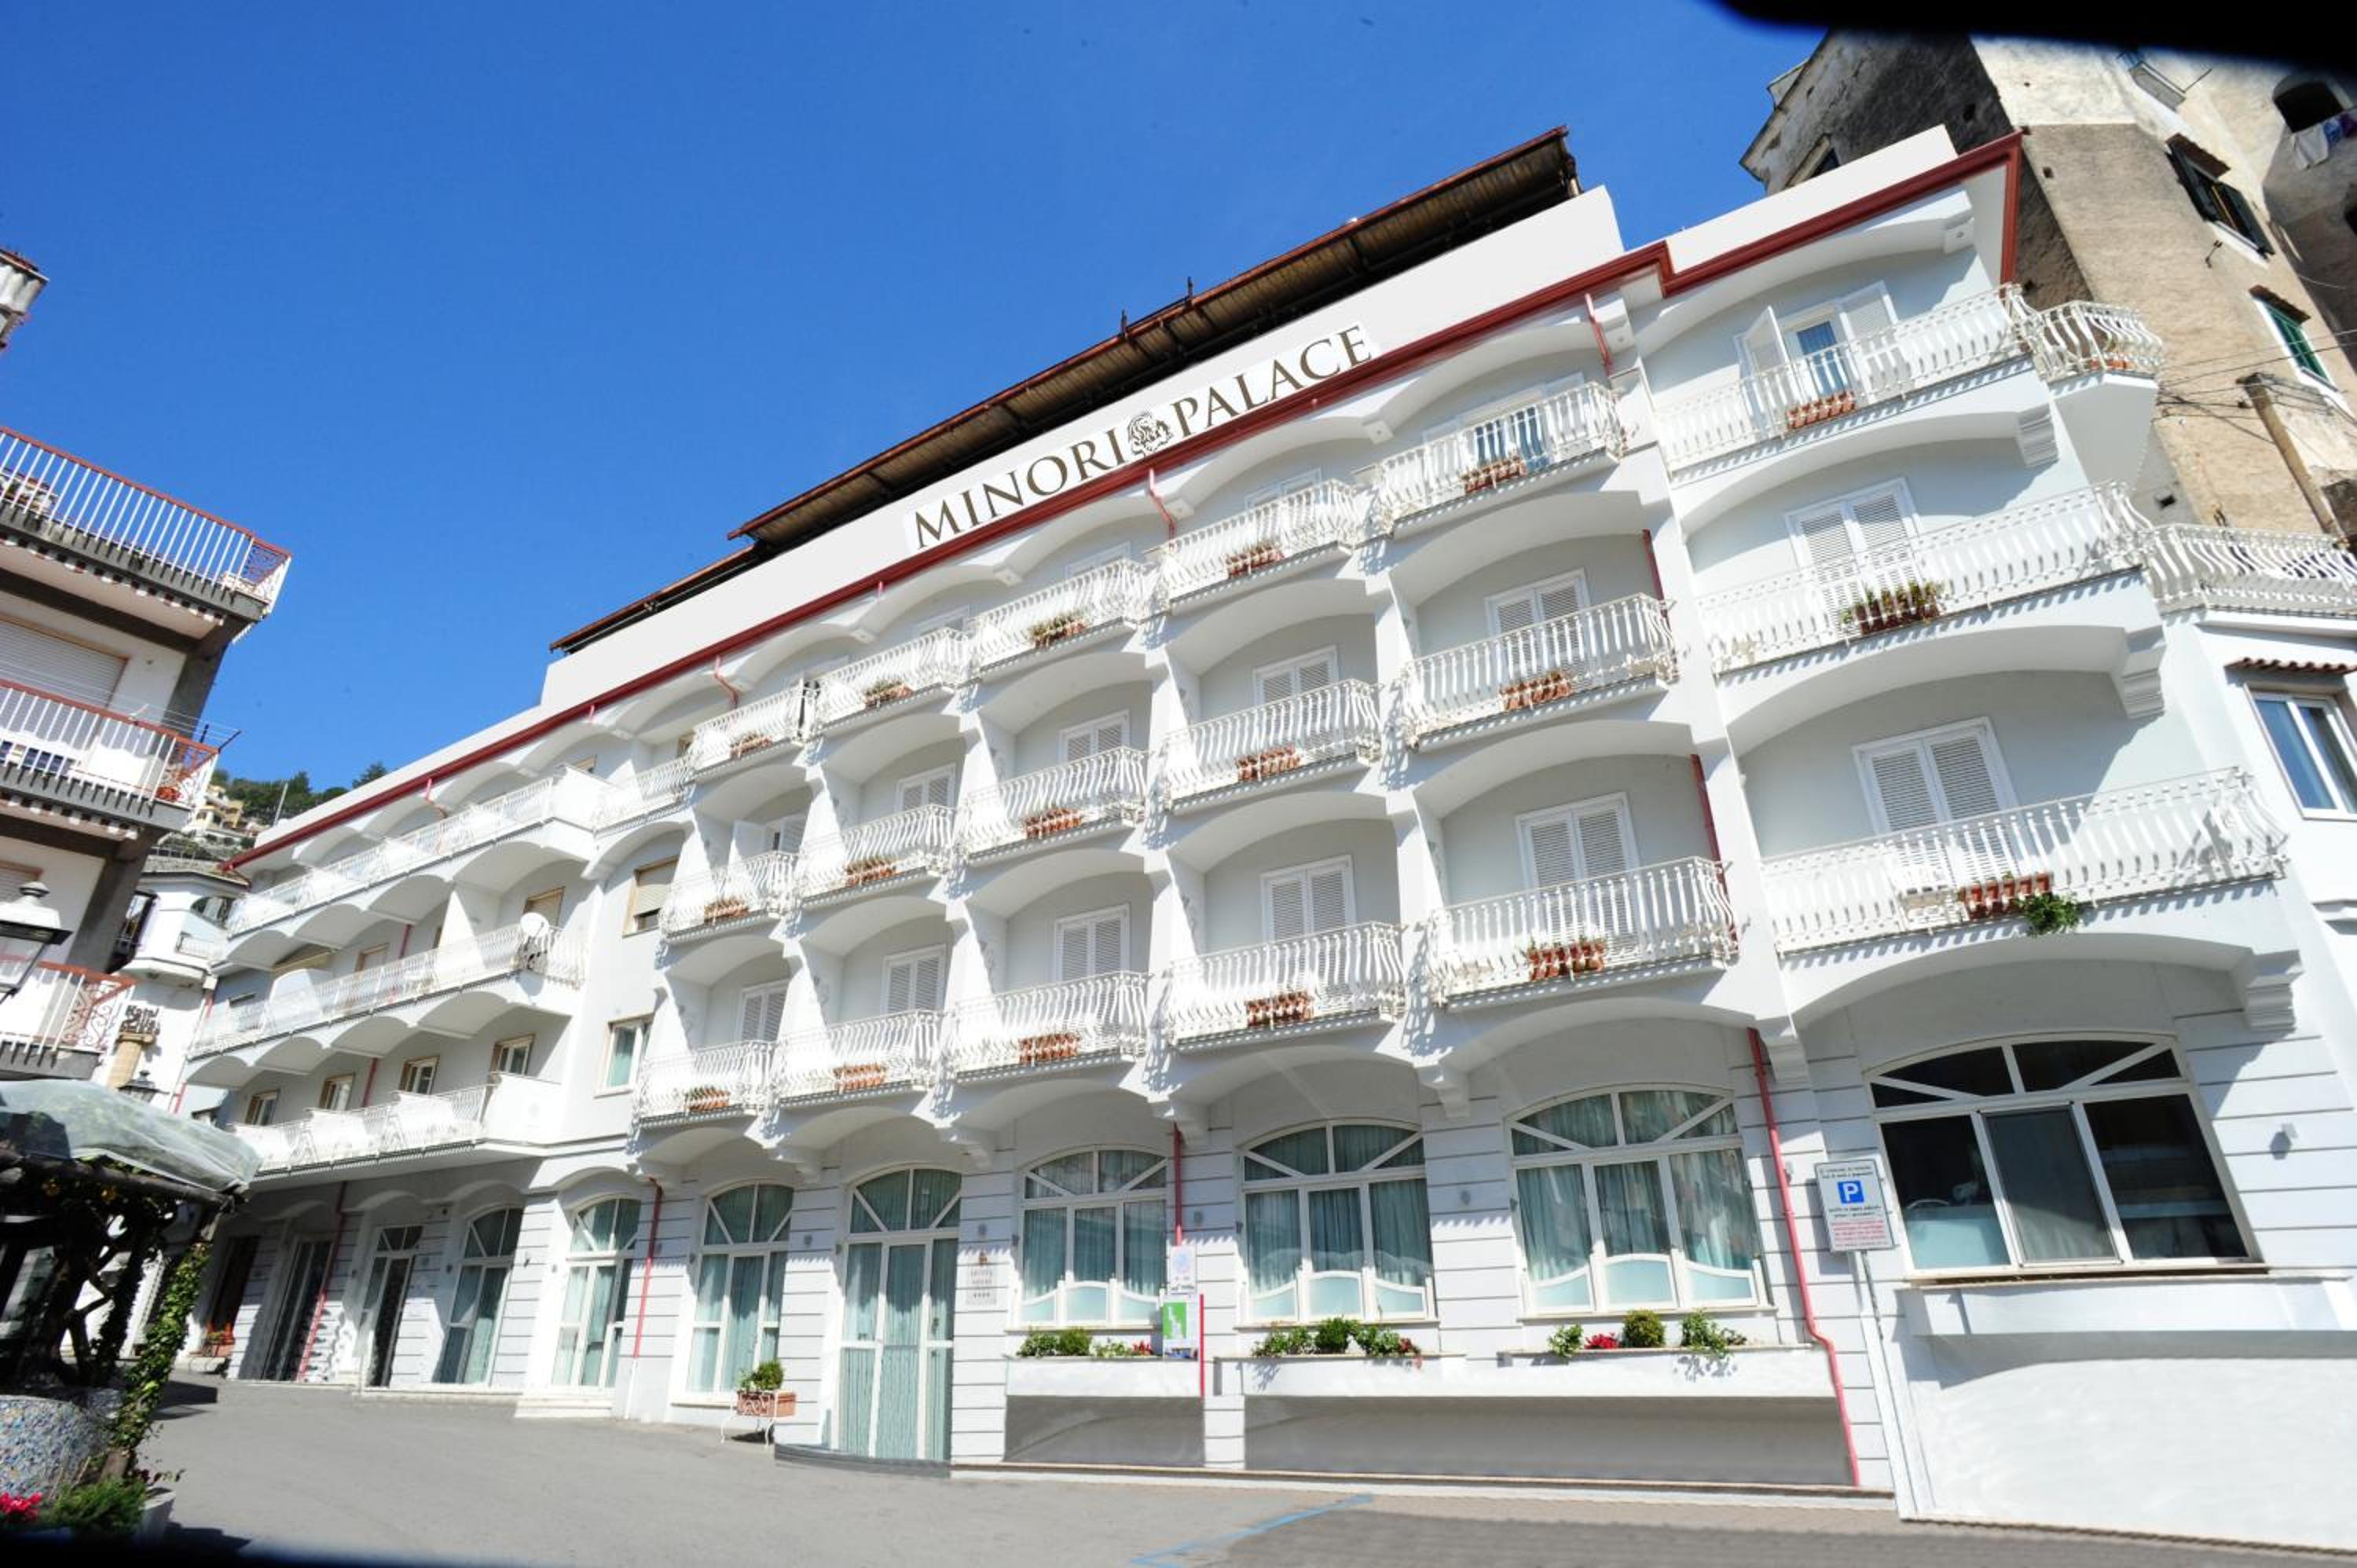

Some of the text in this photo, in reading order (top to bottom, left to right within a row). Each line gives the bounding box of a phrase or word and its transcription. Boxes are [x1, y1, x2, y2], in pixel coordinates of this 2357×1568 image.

[914, 325, 1373, 548] MINORI PALACE
[1842, 1182, 1859, 1202] P
